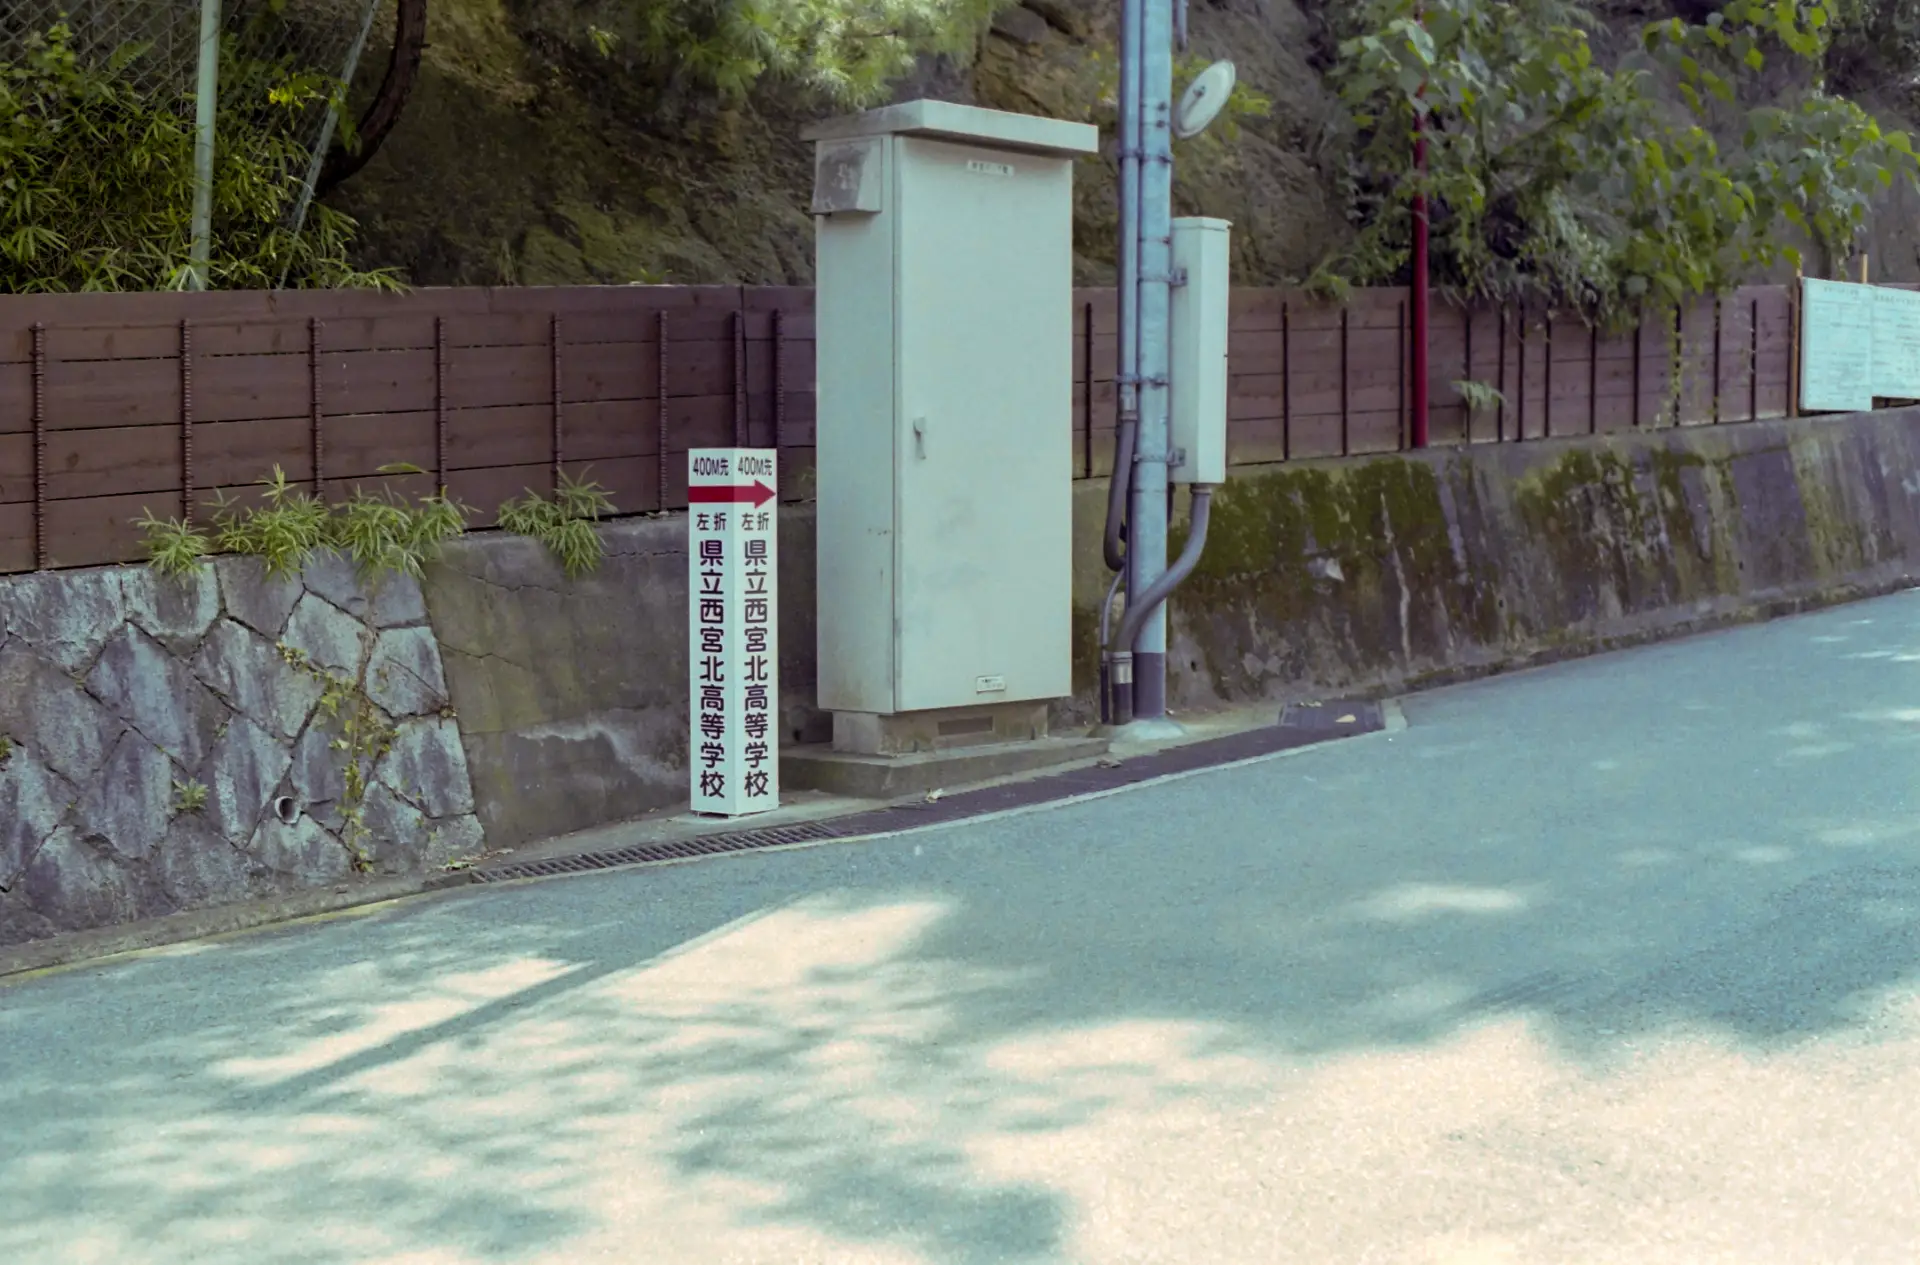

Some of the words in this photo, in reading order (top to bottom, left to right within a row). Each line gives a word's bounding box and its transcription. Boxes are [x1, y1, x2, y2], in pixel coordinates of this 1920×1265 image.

[692, 457, 729, 476] 400M先
[737, 456, 773, 476] 400M先
[696, 512, 727, 531] 左折
[741, 512, 770, 531] 左折
[699, 539, 725, 798] 県立西宮北高等学校
[744, 539, 769, 798] 県立西宮北高等学校
